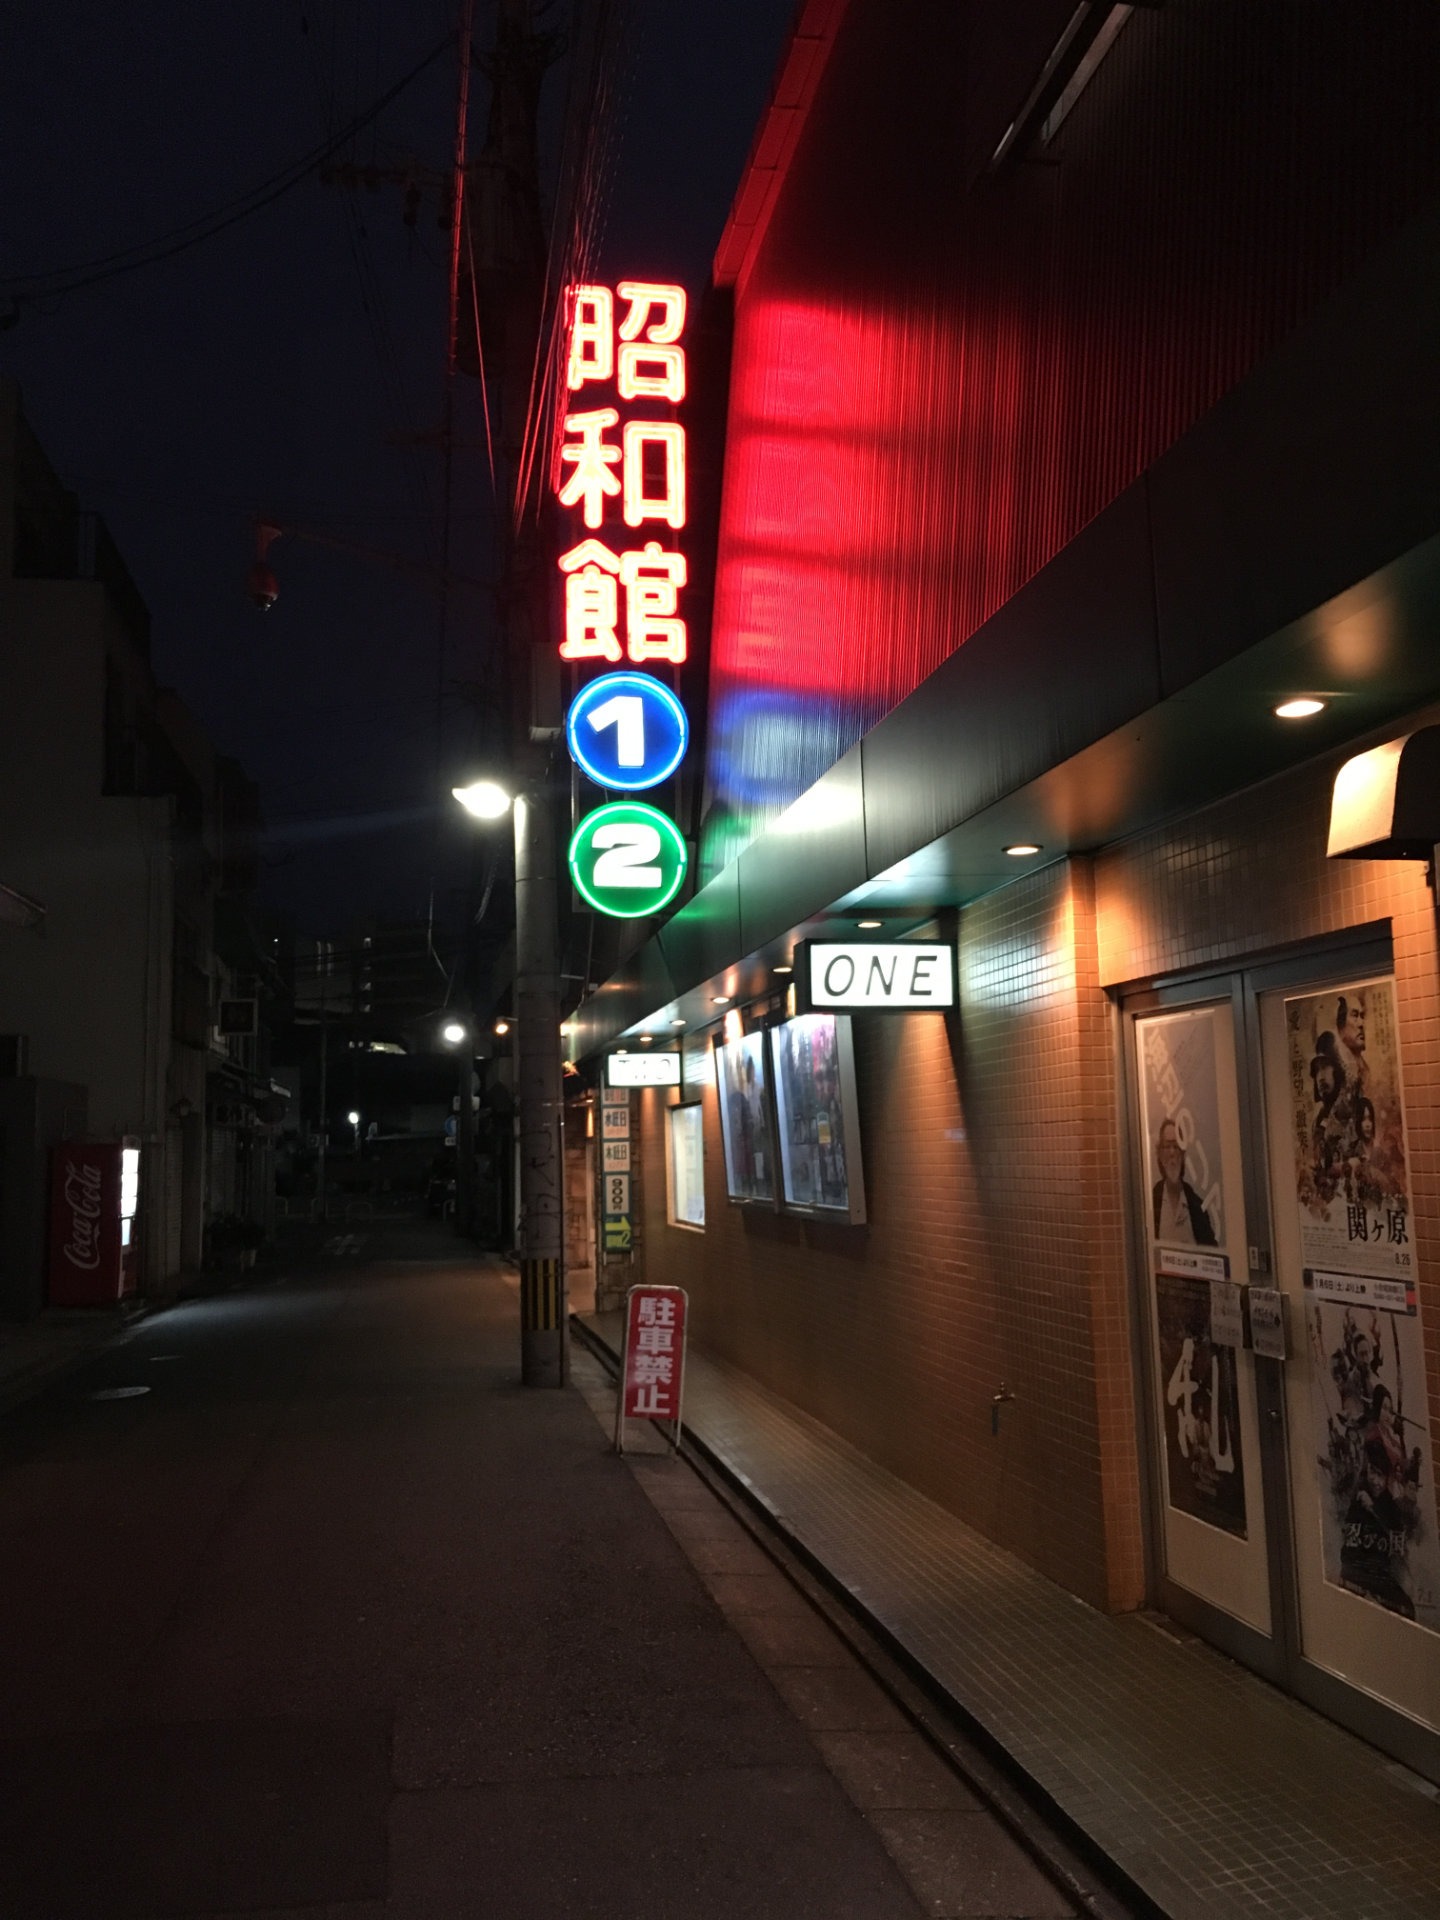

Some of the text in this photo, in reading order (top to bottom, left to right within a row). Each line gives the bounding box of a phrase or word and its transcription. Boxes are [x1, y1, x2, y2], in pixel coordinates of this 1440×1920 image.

[559, 281, 687, 662] 昭和館
[586, 695, 645, 768] 1
[591, 823, 662, 888] 2
[823, 954, 938, 997] ONE
[632, 1297, 676, 1414] 駐車禁止
